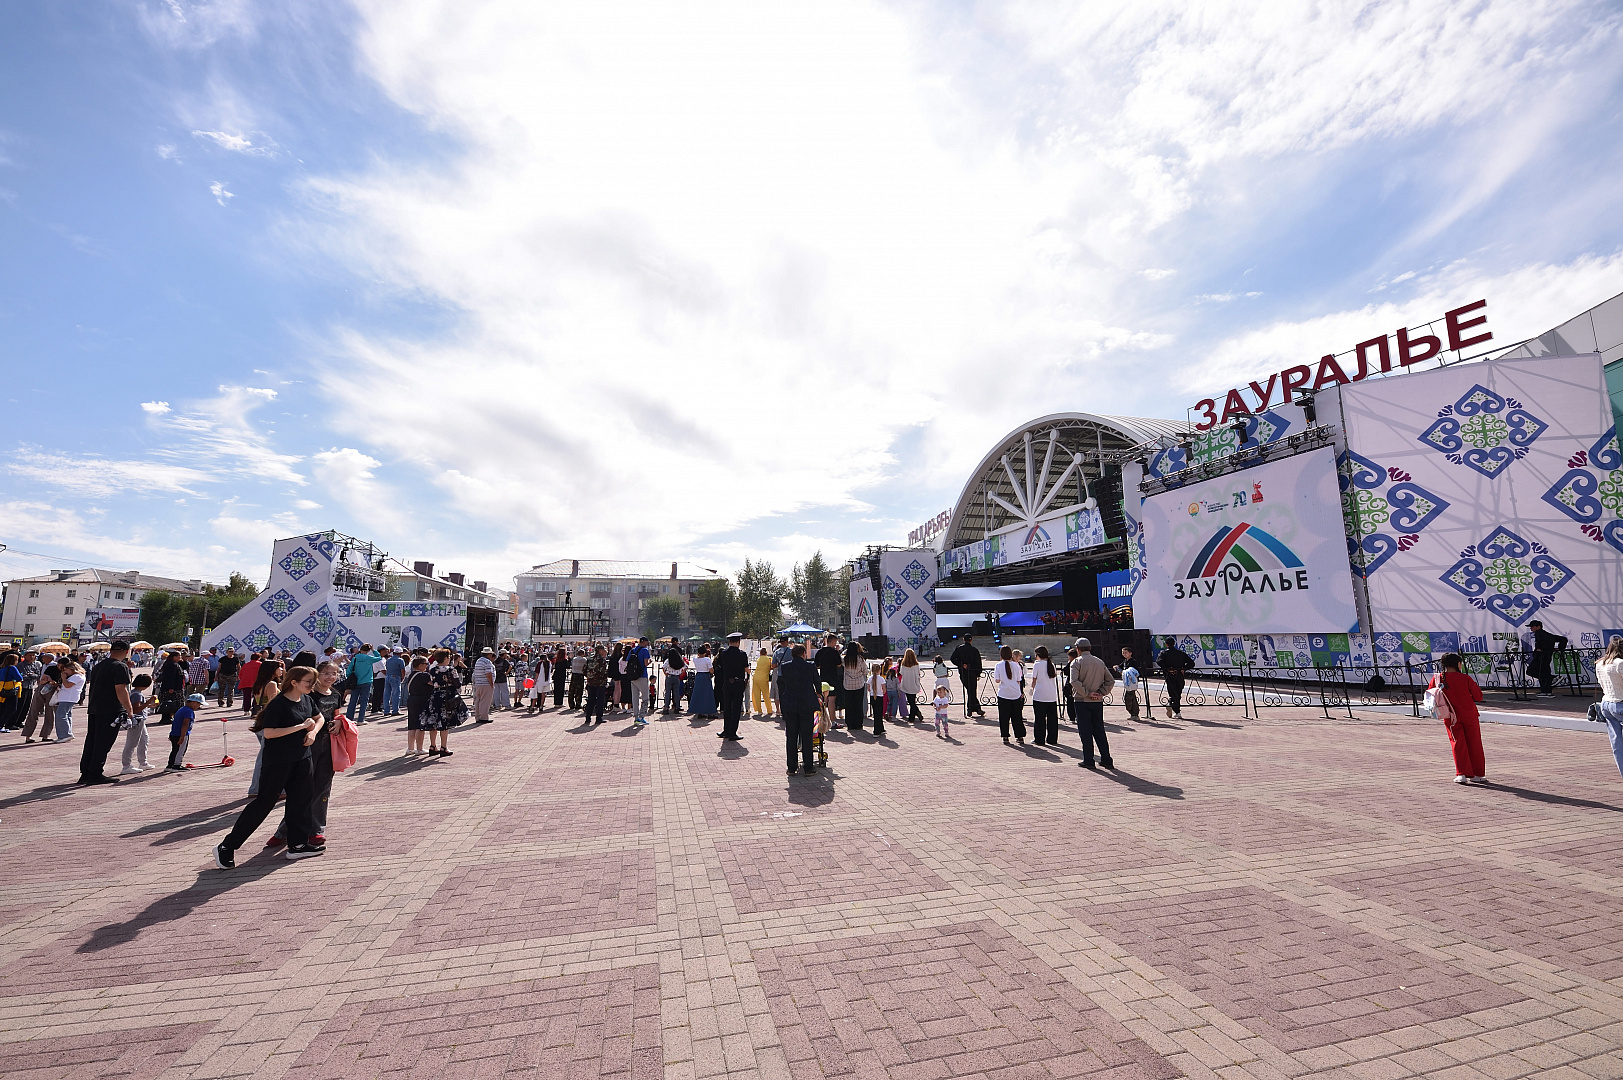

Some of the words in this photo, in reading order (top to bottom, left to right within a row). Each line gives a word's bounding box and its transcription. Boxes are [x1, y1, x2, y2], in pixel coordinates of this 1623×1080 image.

[1194, 298, 1494, 432] ЗАУРАЛЬЕ
[1020, 539, 1052, 554] ЗАУРАЛЬЕ
[1101, 584, 1133, 599] ПРИБЛИ
[1173, 562, 1309, 600] ЗАУРАЛЬЕ
